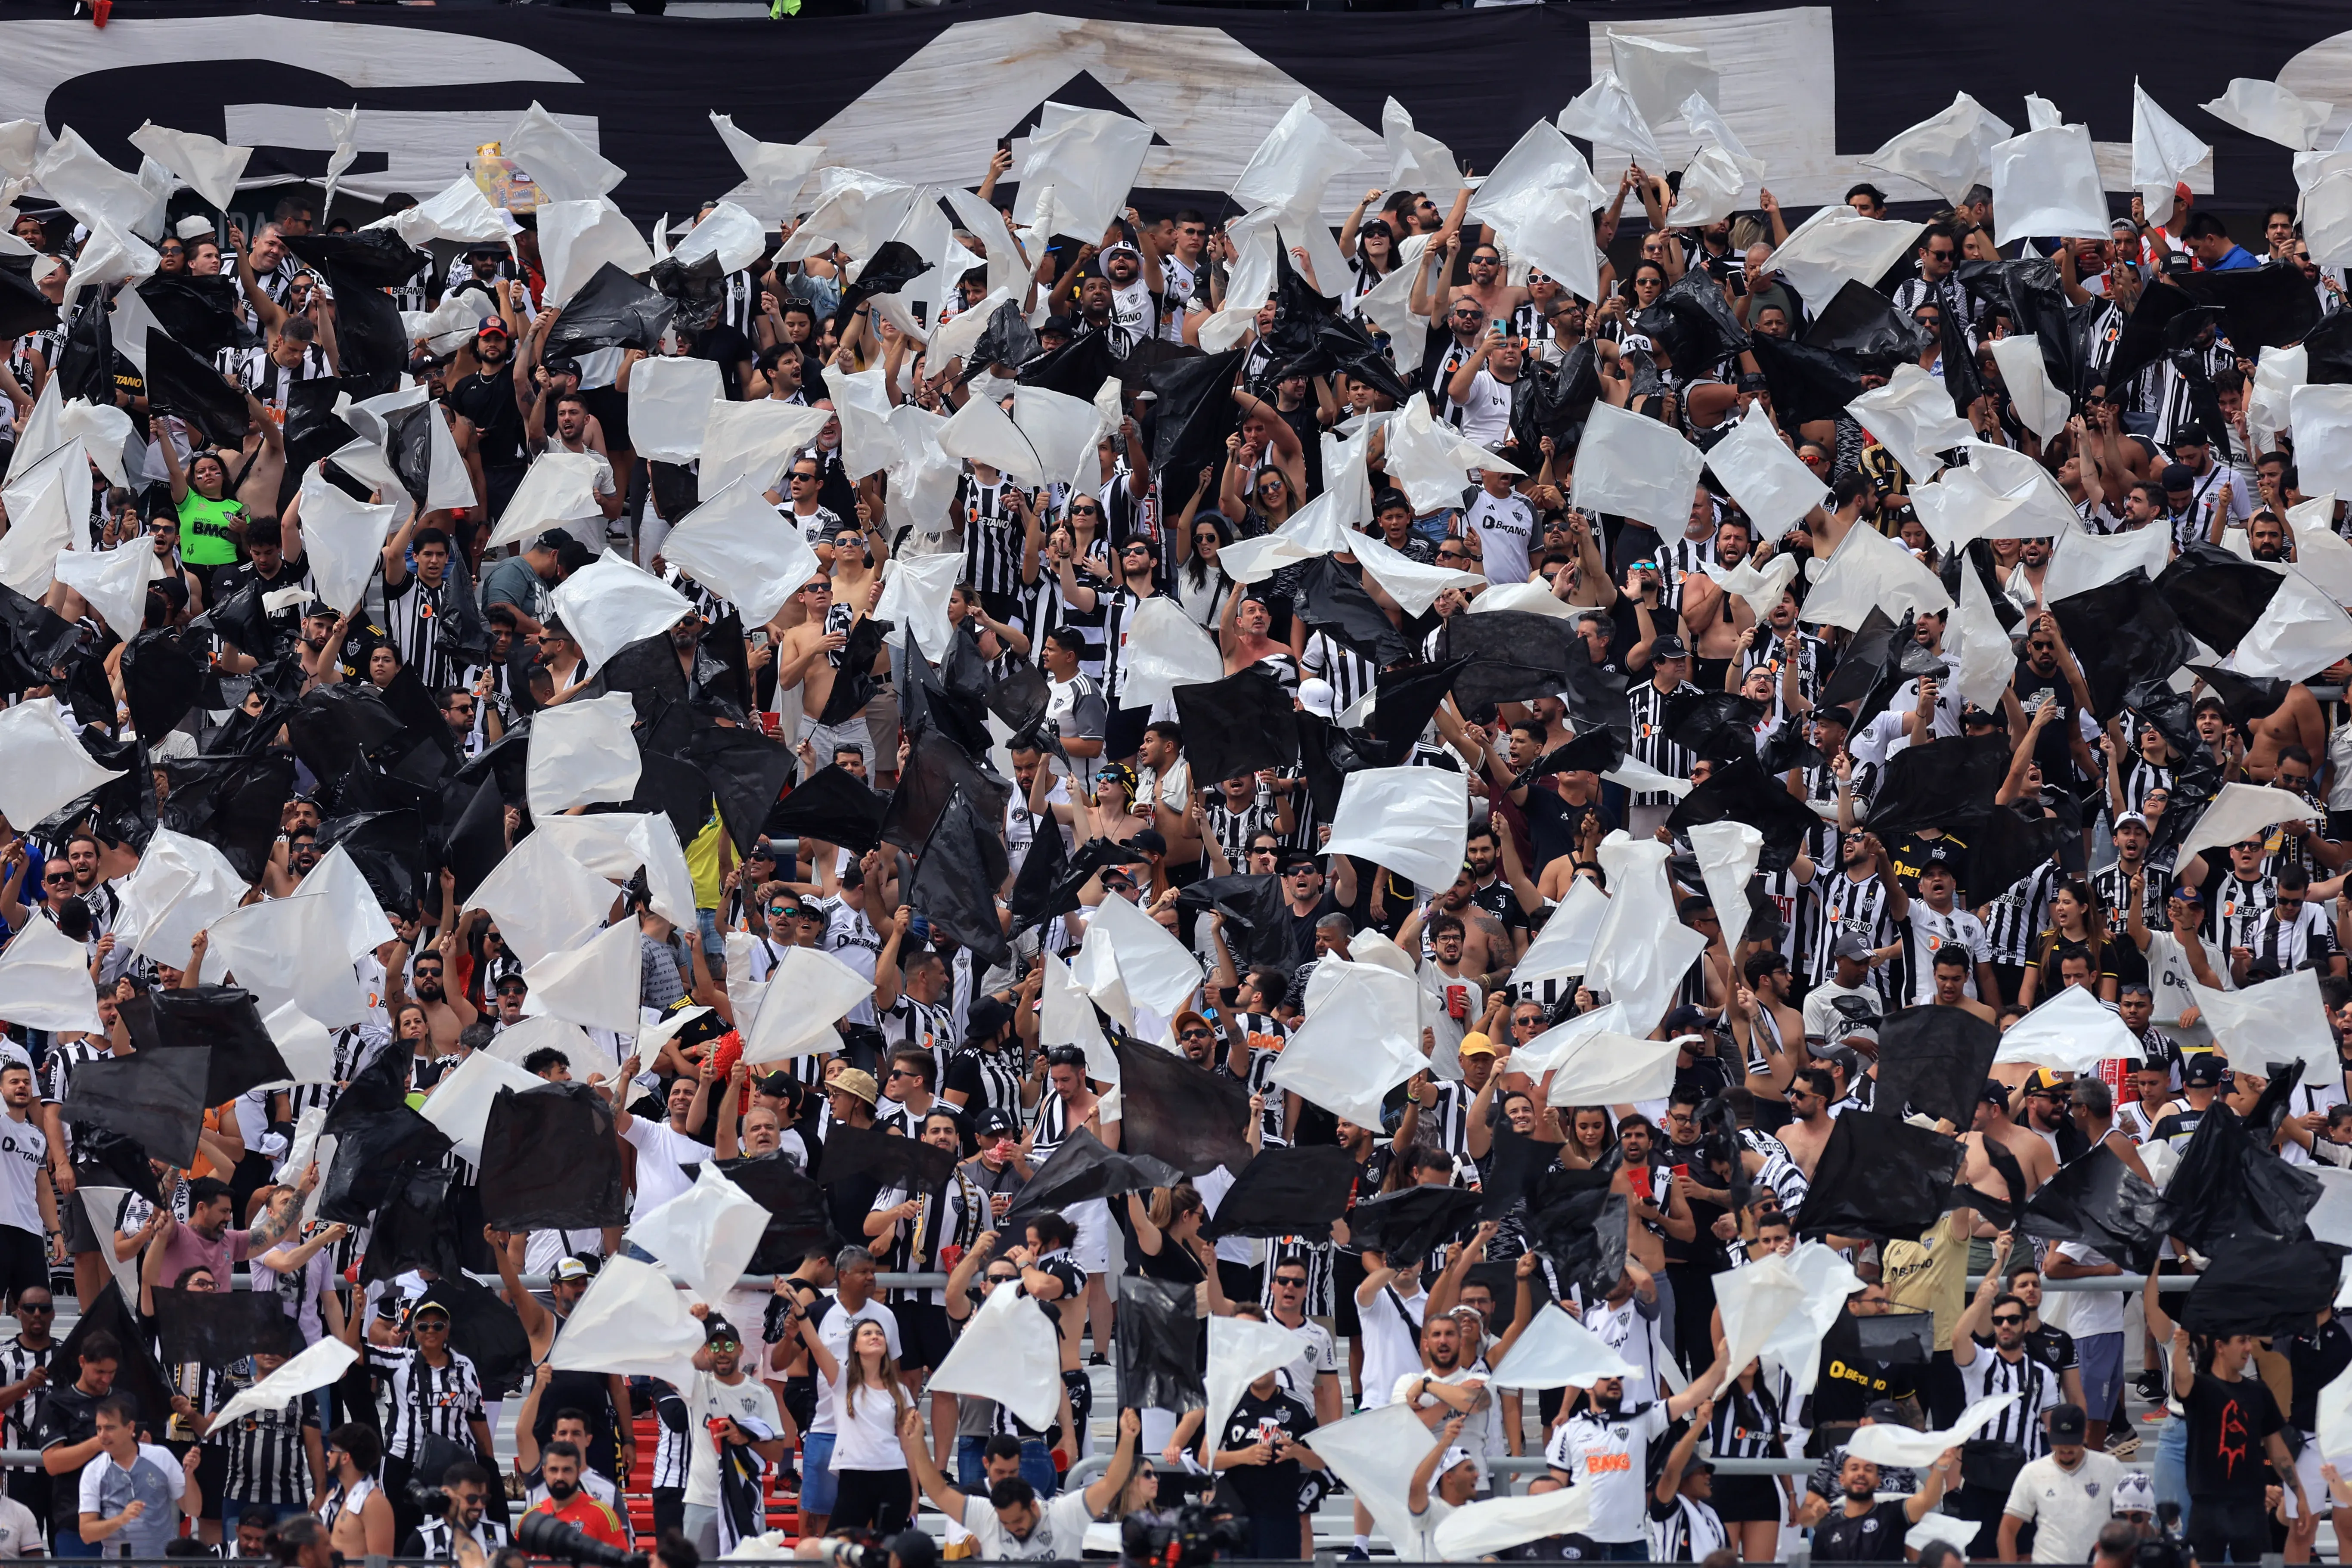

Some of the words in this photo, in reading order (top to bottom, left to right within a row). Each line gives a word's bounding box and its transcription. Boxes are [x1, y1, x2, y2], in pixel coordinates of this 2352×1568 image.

[392, 286, 425, 297] BETANO
[39, 330, 70, 346] BETAN
[193, 522, 228, 538] BMG
[1223, 847, 1244, 858] BETA
[1837, 915, 1873, 933] BETANO
[934, 1038, 955, 1050] BETA
[1247, 1030, 1285, 1052] BMG
[407, 1391, 467, 1407] CIXA
[1586, 1454, 1631, 1475] BMG
